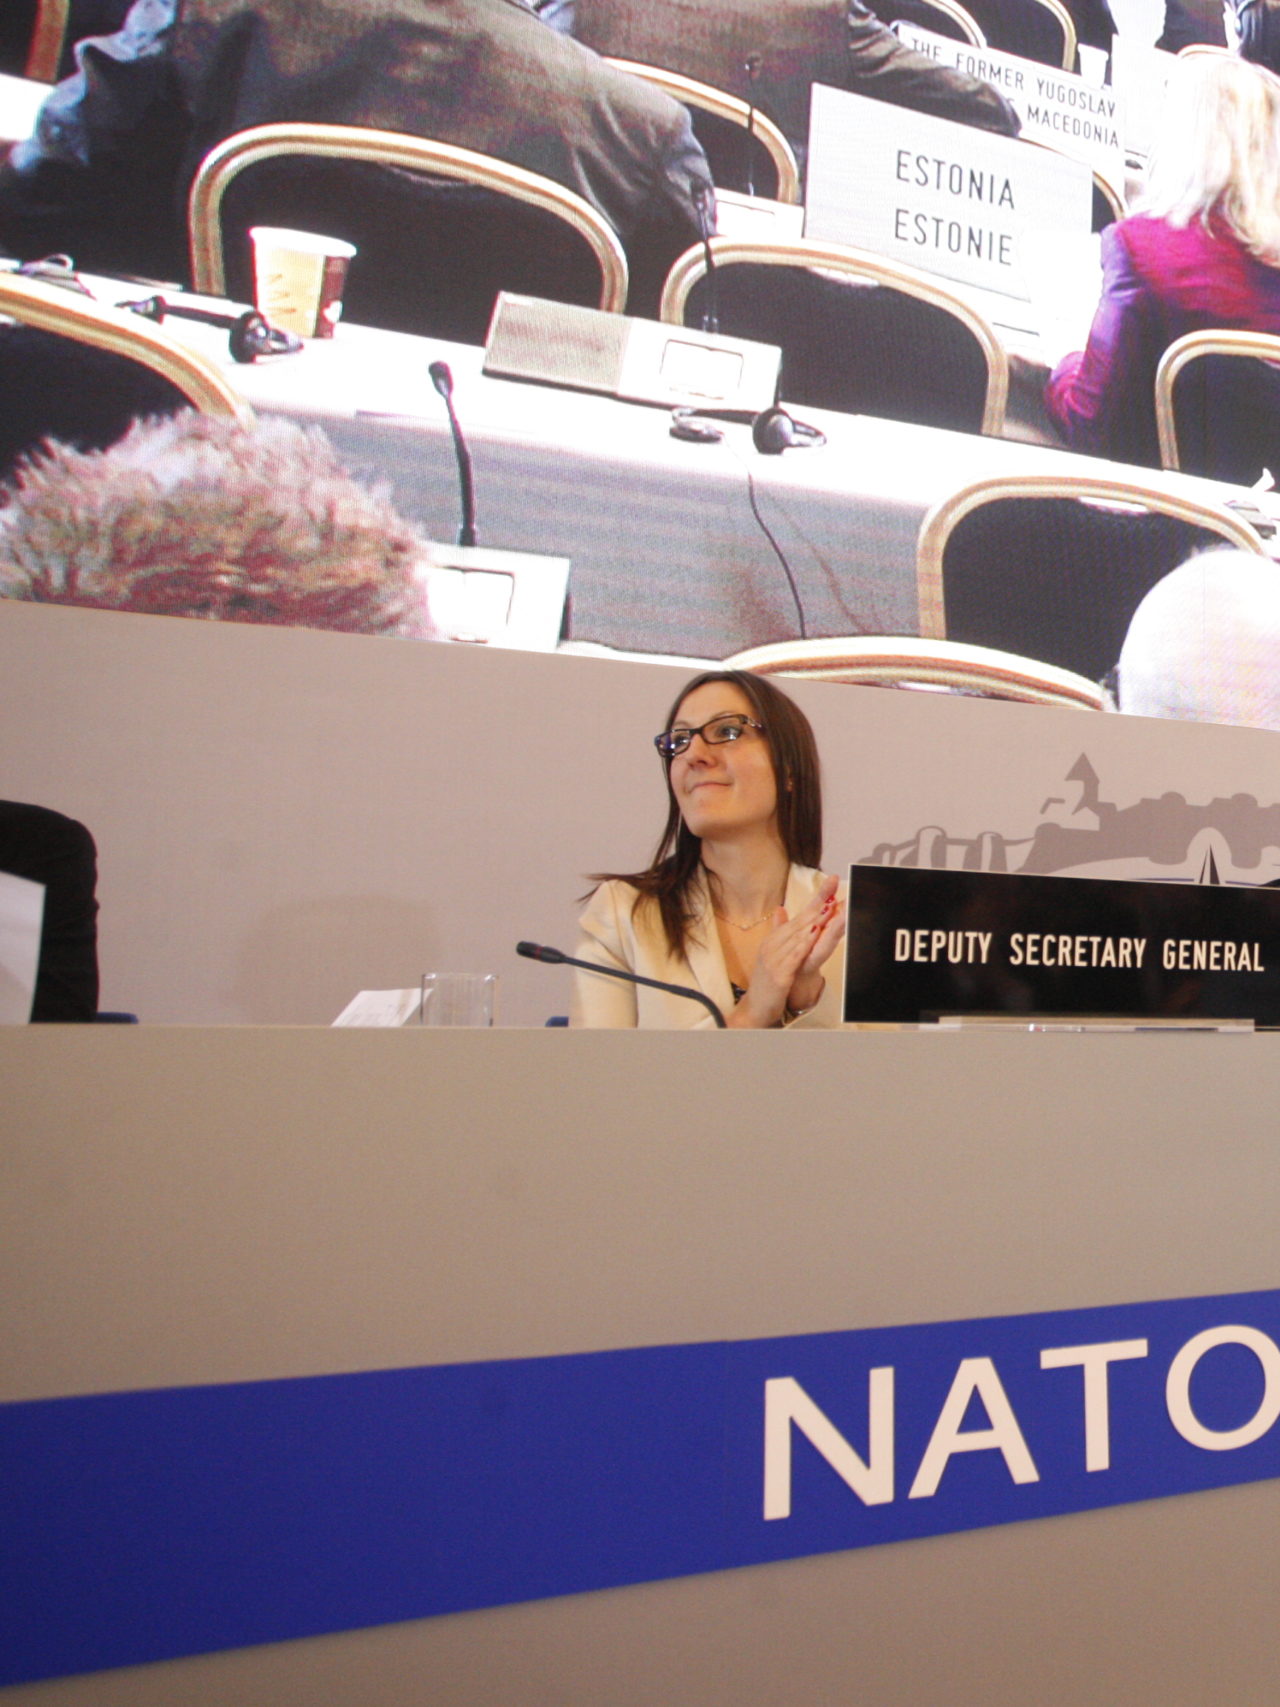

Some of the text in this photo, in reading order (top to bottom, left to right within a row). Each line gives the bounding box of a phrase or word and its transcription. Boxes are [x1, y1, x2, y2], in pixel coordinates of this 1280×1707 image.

[956, 52, 1024, 91] FORMER
[1036, 77, 1116, 119] YUGOSLAV
[1027, 103, 1120, 148] MACEDONIA
[896, 149, 1015, 210] ESTONIA
[895, 208, 1013, 266] ESTONIE
[895, 929, 1265, 972] DEPUTY SECRETARY GENERAL
